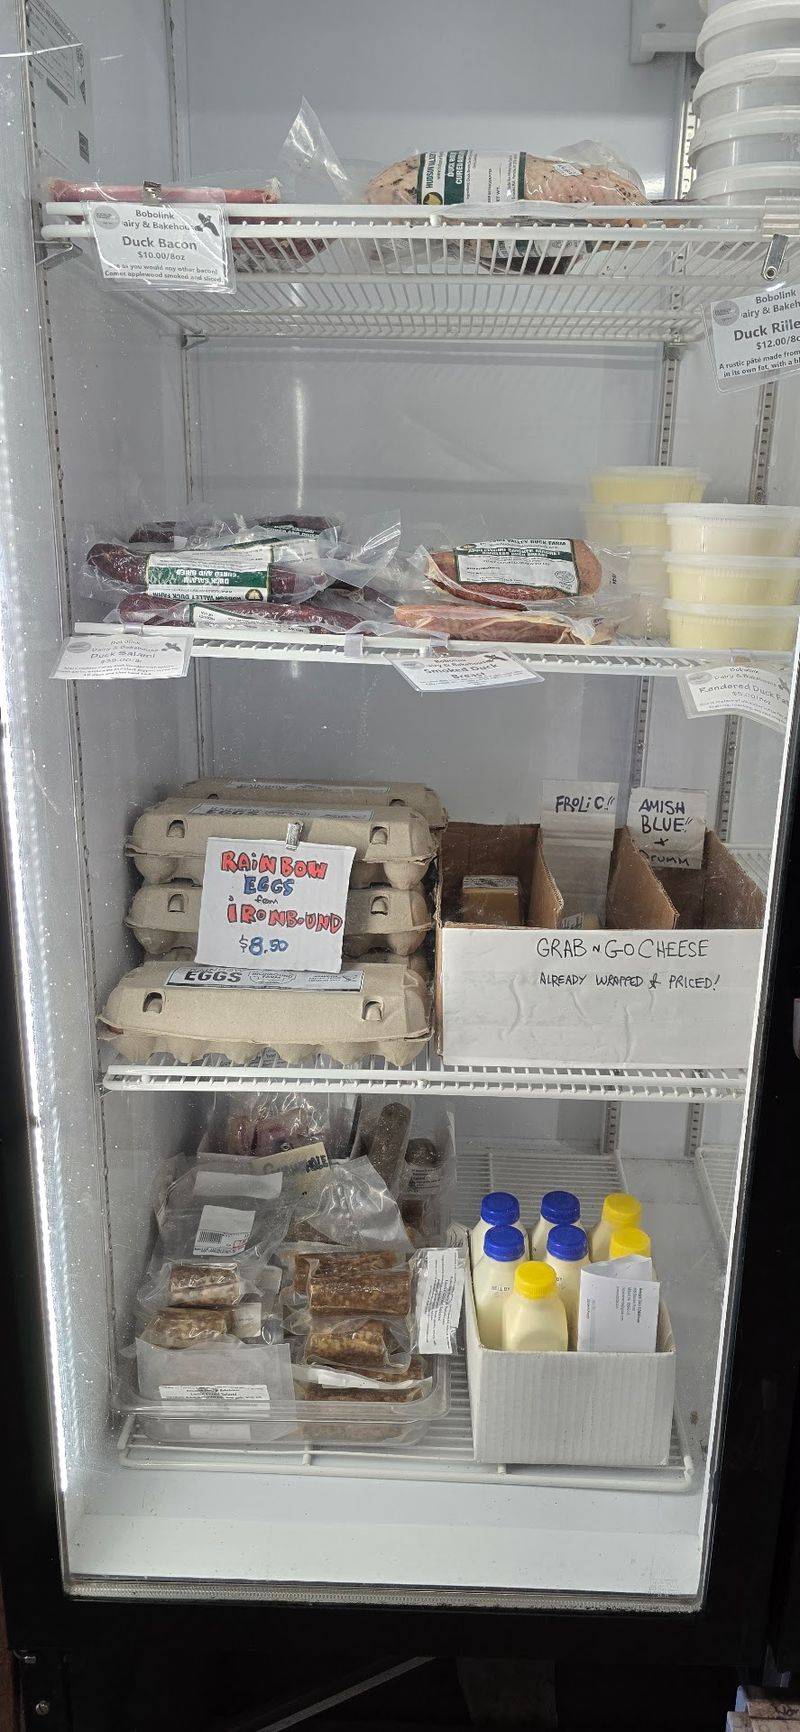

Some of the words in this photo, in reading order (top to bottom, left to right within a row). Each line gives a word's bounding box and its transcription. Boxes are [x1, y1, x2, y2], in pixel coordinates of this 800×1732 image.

[136, 210, 174, 220] Bobolink
[123, 220, 140, 229] airy
[153, 222, 196, 232] Bakehou
[122, 236, 154, 248] Duck
[159, 238, 198, 250] Bacon
[138, 251, 186, 261] $10.00/8oz
[756, 289, 796, 304] Bobolink
[741, 309, 760, 319] airy
[762, 306, 770, 315] &
[734, 325, 768, 341] Duck
[726, 360, 744, 369] rustic
[763, 353, 782, 362] made
[771, 360, 787, 369] with
[471, 664, 497, 672] Duck
[752, 685, 776, 699] Duck
[638, 799, 686, 815] AMISH
[244, 874, 294, 896] EGGS
[254, 895, 278, 904] from
[239, 934, 289, 956] $8.50
[536, 938, 587, 959] GRAB
[605, 939, 634, 959] GO
[638, 938, 709, 959] CHEESE
[184, 970, 242, 983] EGGS
[539, 972, 587, 987] ALREADY
[596, 974, 644, 987] WRAPPED
[669, 974, 720, 991] PRICED!
